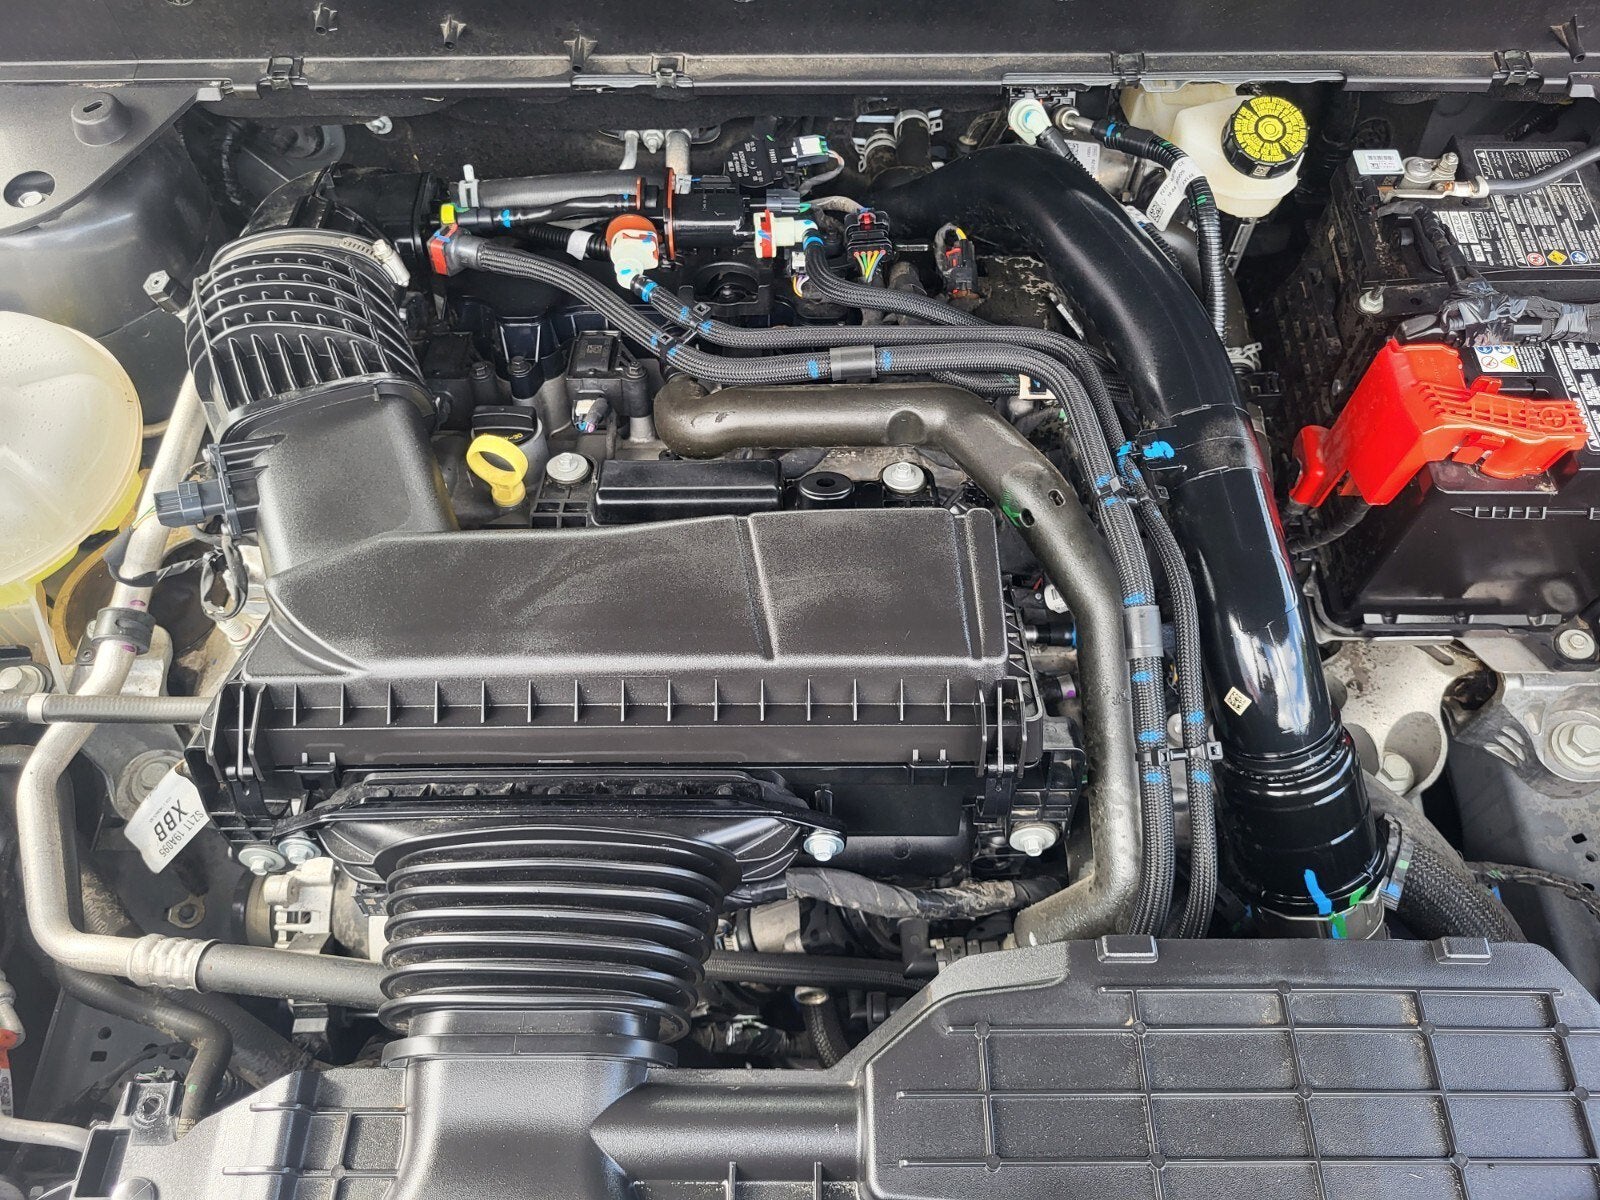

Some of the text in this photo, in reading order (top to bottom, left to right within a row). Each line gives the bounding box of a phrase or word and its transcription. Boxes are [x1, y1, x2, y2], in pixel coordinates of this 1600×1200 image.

[1474, 213, 1490, 239] FoMoCo
[1481, 240, 1492, 252] MF
[153, 798, 188, 842] XBB
[159, 831, 185, 857] 19A095
